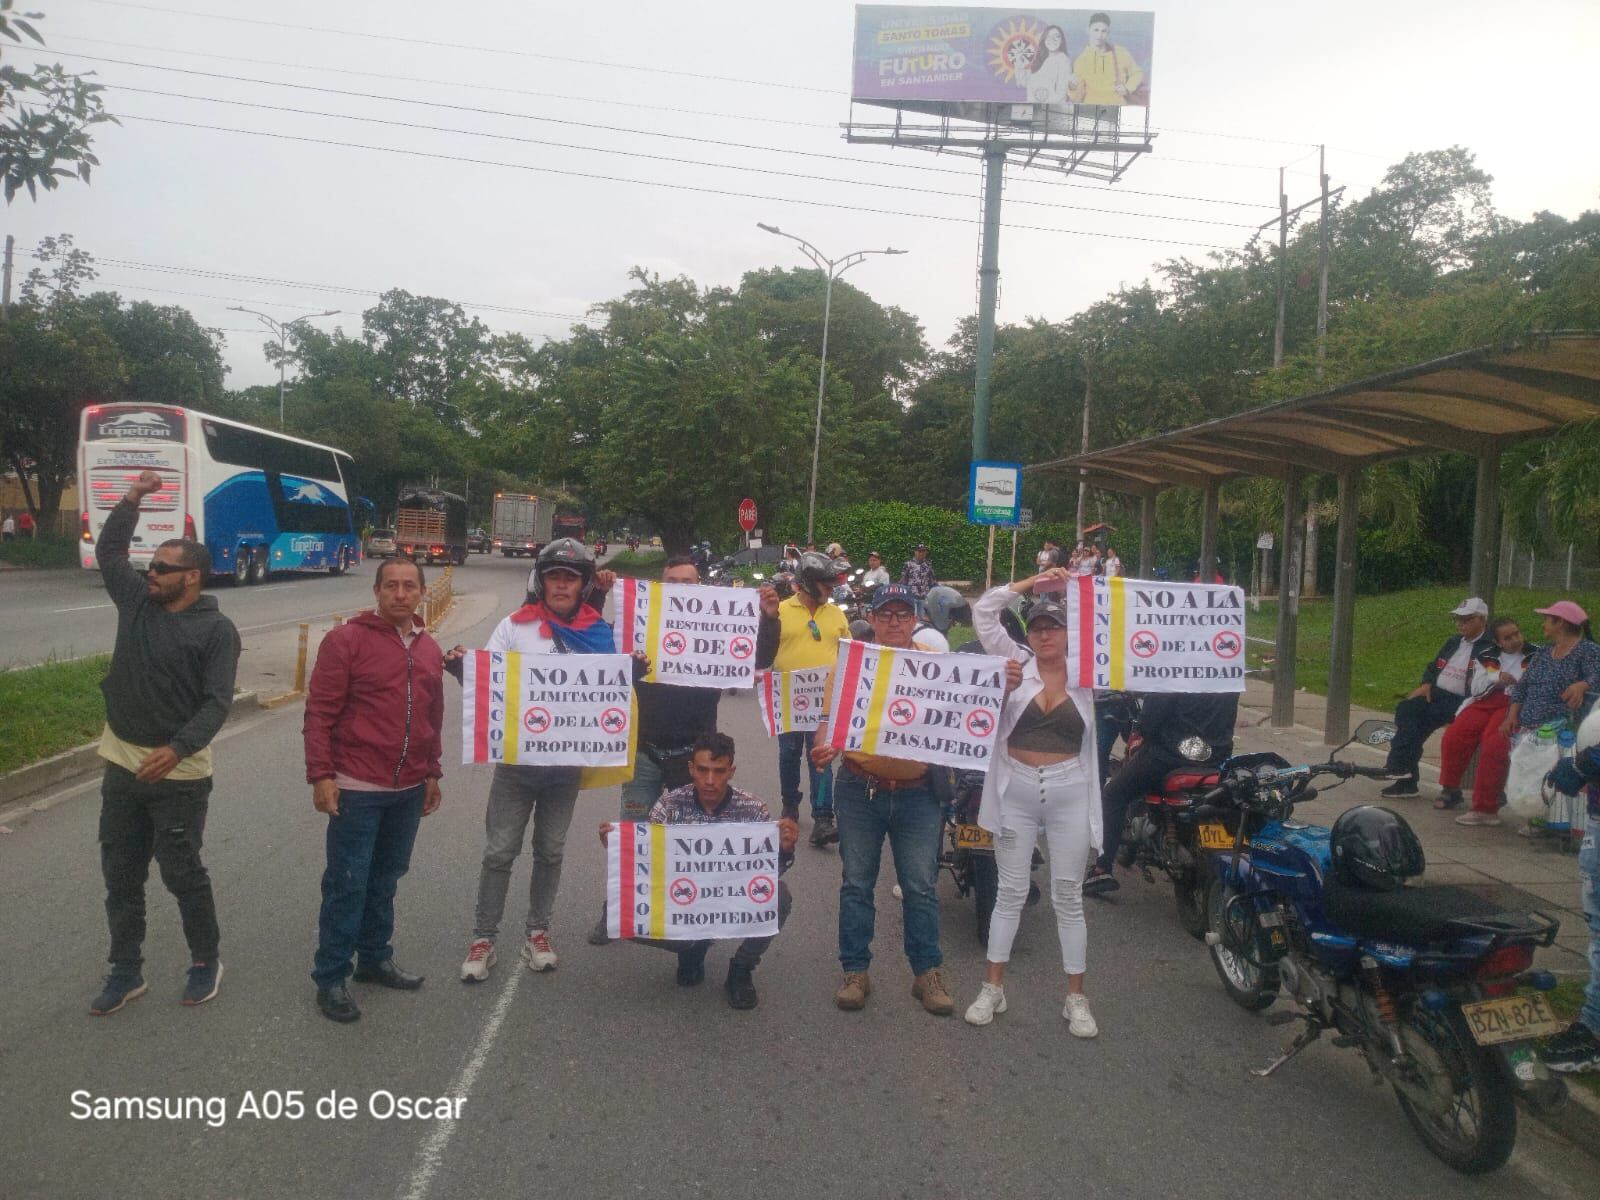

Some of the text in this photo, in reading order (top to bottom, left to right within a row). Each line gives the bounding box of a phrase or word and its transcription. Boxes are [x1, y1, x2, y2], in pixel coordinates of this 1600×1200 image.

[880, 29, 921, 41] SANTO
[879, 52, 966, 75] FUTURO
[880, 72, 963, 87] EN SANTANDER
[98, 426, 171, 438] Copetran
[740, 508, 756, 521] PARE
[668, 596, 757, 618] NO A LA
[1135, 590, 1242, 609] NO A LA
[665, 619, 758, 635] RESTRICCION
[1136, 613, 1243, 626] LIMITACION
[693, 637, 725, 655] DE
[1161, 640, 1212, 652] DE LA
[528, 667, 629, 686] NO A LA
[661, 661, 751, 678] PASAJERO
[899, 658, 1002, 689] NO A LA
[1132, 666, 1243, 679] PROPIEDAD
[795, 672, 820, 683] NO
[528, 690, 629, 703] LIMITACION
[895, 684, 1002, 709] RESTRICCION
[553, 715, 601, 728] DE LA
[921, 707, 963, 730] DE
[524, 741, 627, 753] PROPIEDAD
[883, 730, 988, 759] PASAJERO
[673, 836, 776, 856] NO A LA
[674, 858, 777, 873] LIMITACION
[700, 886, 747, 898] DE LA
[672, 910, 777, 925] PROPIEDAD
